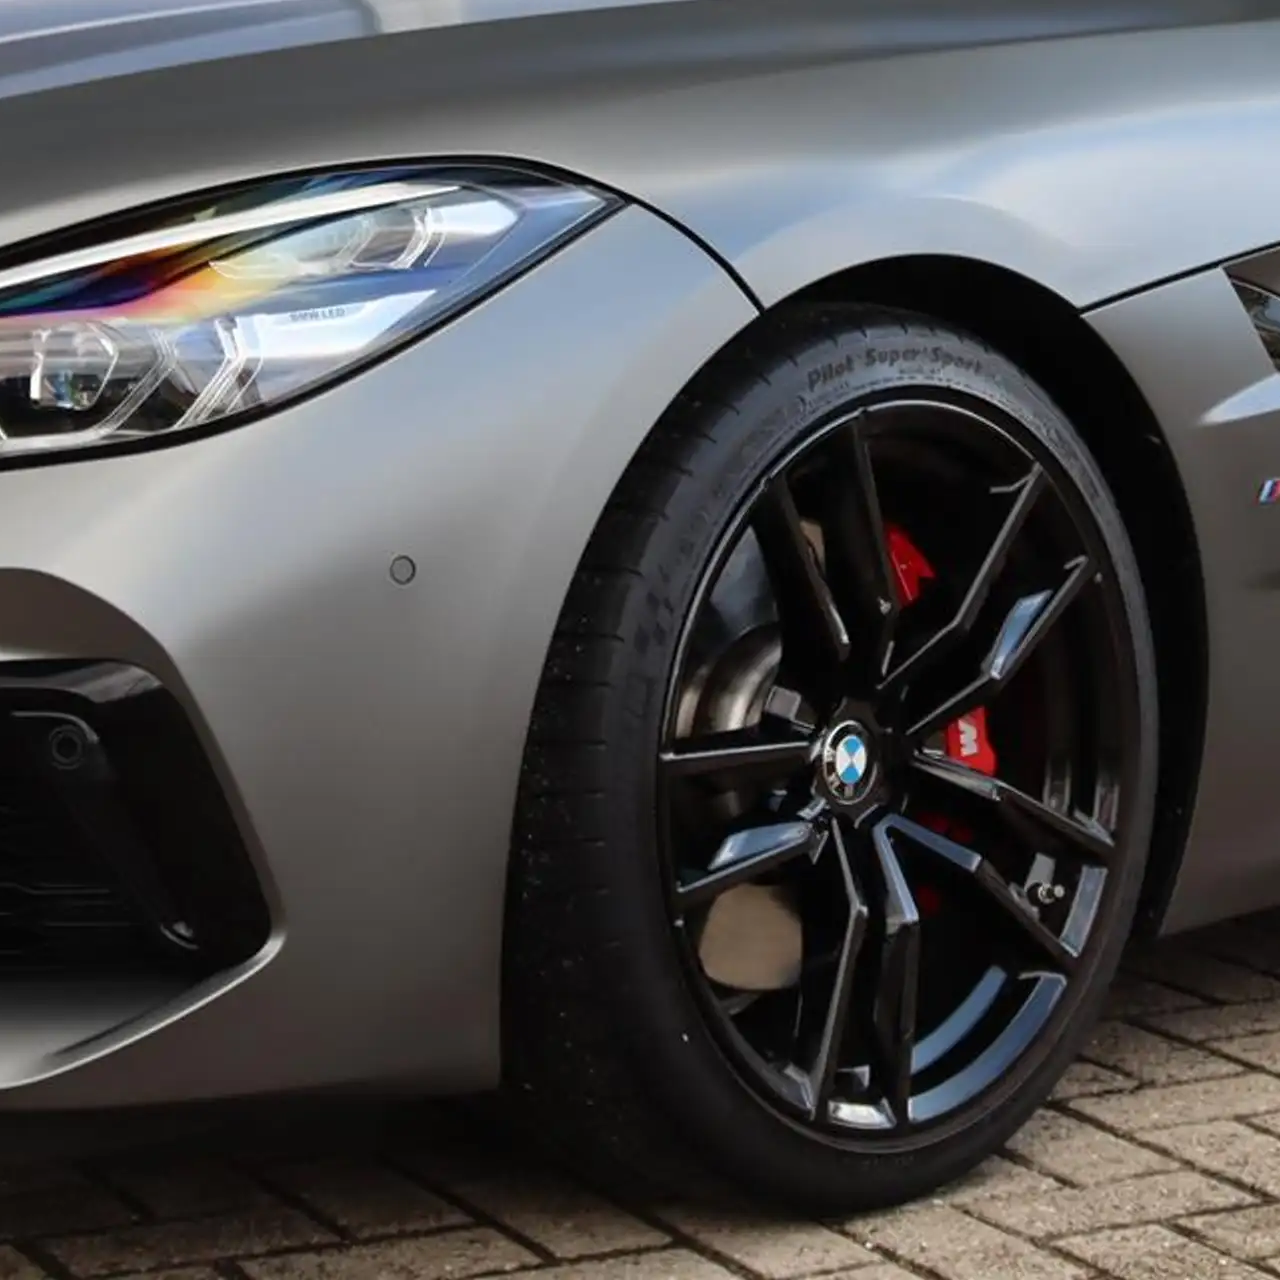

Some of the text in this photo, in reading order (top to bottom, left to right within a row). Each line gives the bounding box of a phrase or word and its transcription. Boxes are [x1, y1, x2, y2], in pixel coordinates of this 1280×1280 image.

[807, 344, 984, 393] Pilot Super Sport
